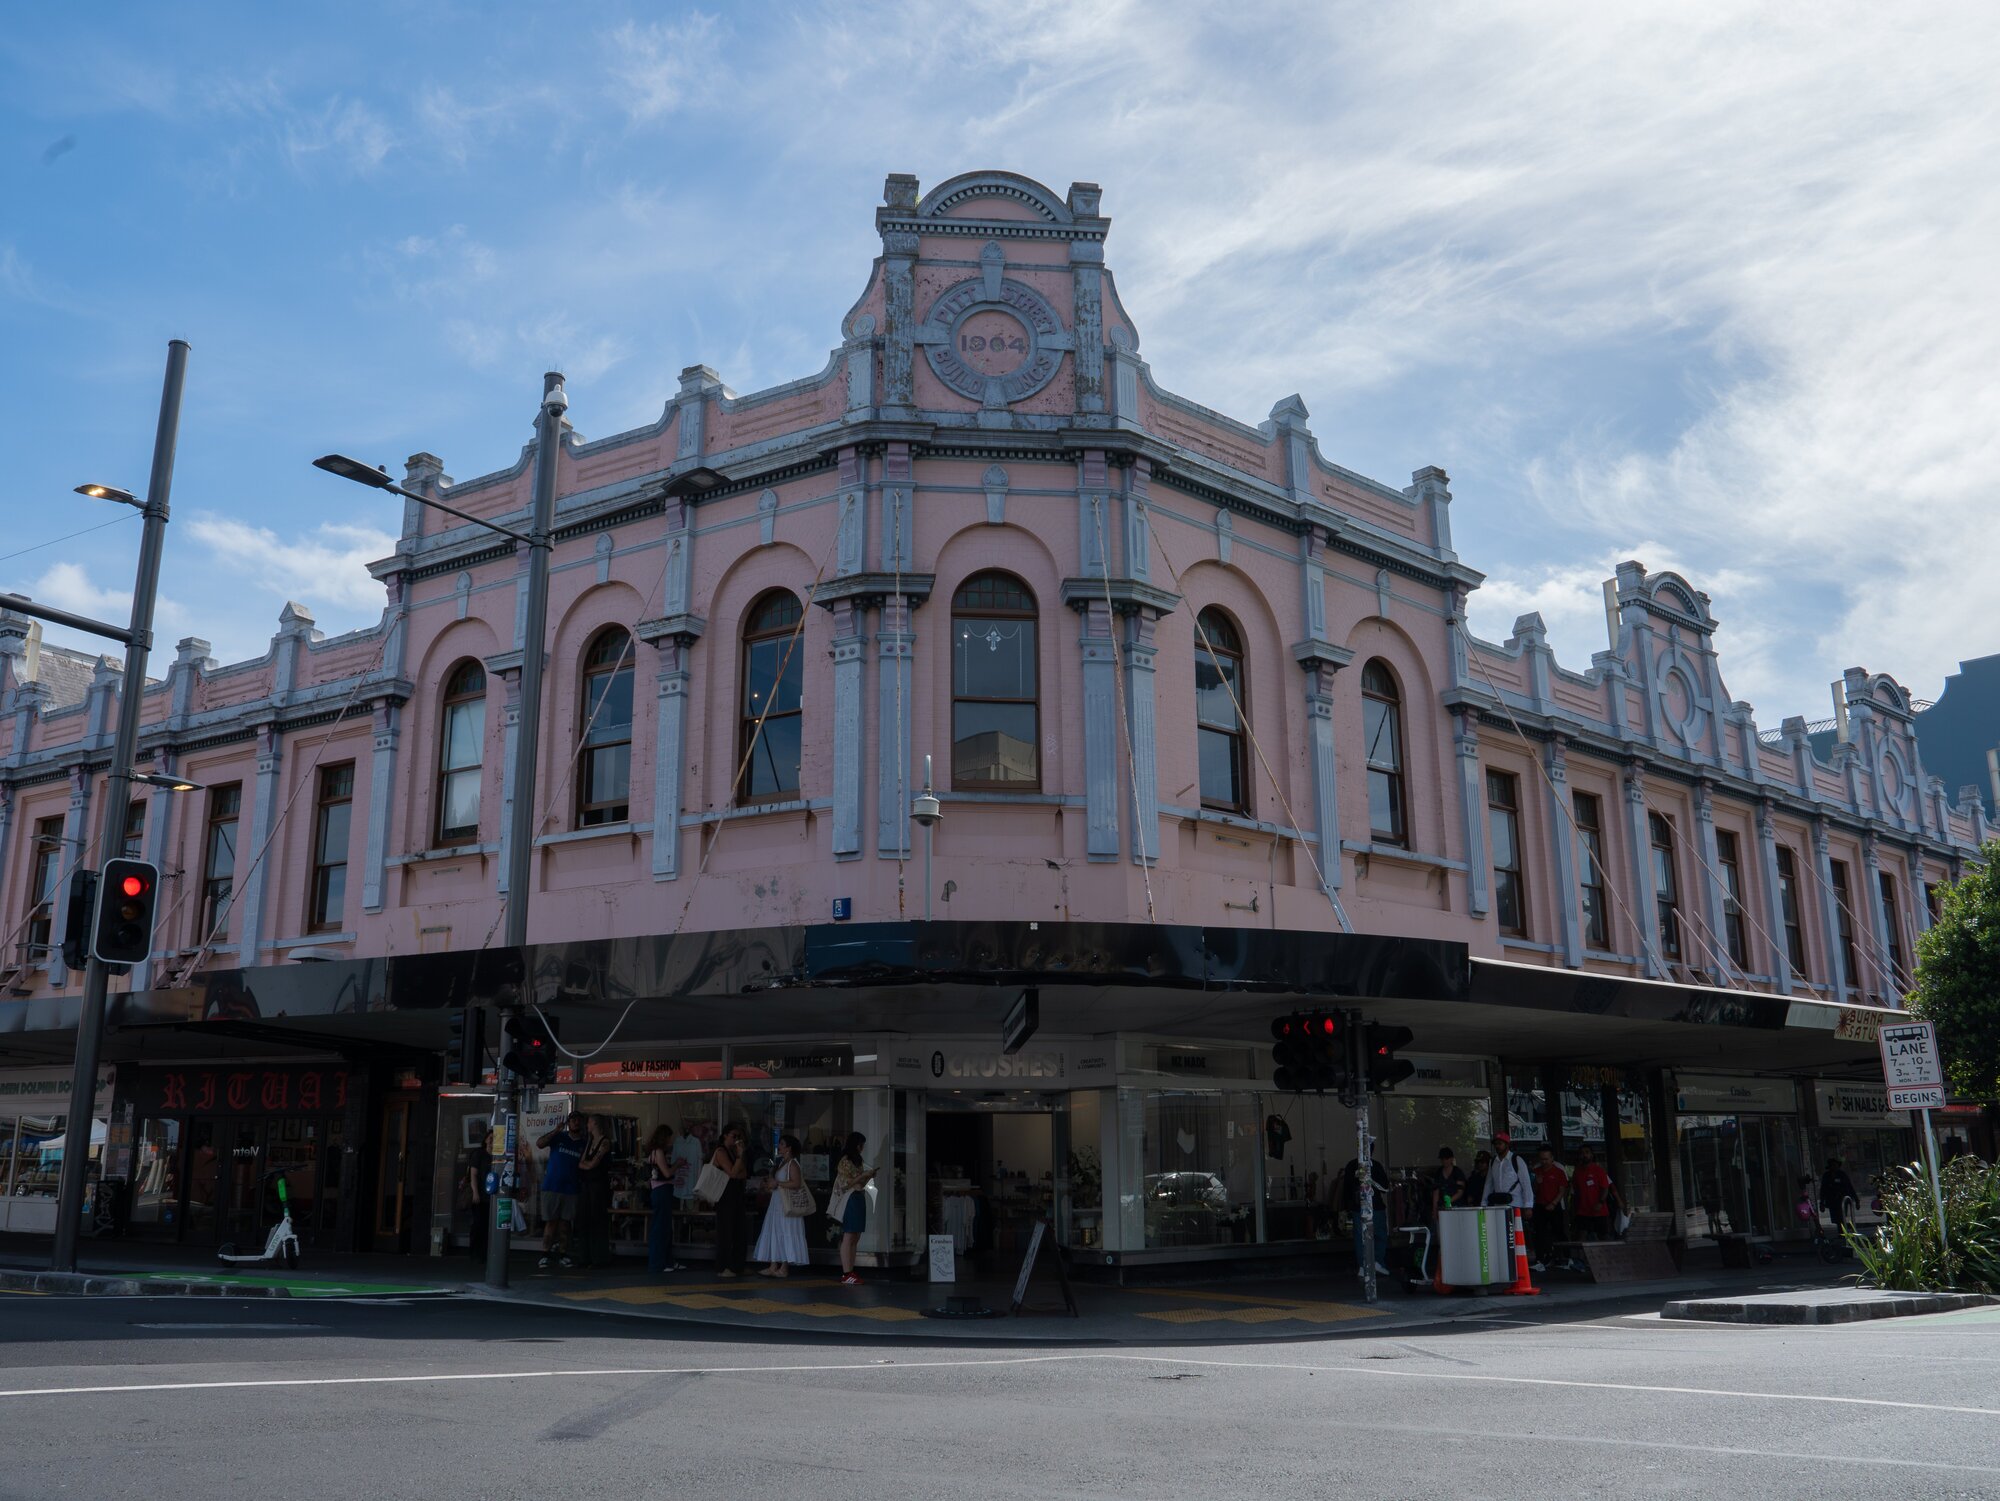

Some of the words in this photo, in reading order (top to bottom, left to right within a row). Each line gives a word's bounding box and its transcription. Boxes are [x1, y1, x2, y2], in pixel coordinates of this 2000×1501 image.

[935, 285, 976, 326] PITT
[1001, 286, 1056, 335] STREET
[961, 335, 1025, 354] 1904
[1849, 1010, 1884, 1027] BUANA
[1889, 1042, 1928, 1056] LANE
[621, 1061, 643, 1072] SLOW
[645, 1059, 681, 1071] FASHION
[948, 1051, 1058, 1078] CRUSHES
[1184, 1056, 1206, 1069] MADE
[1416, 1068, 1441, 1079] VINTAGE
[20, 1081, 57, 1095] DOLPHIN
[1855, 1097, 1877, 1112] NAILS
[1894, 1091, 1937, 1104] BEGINS
